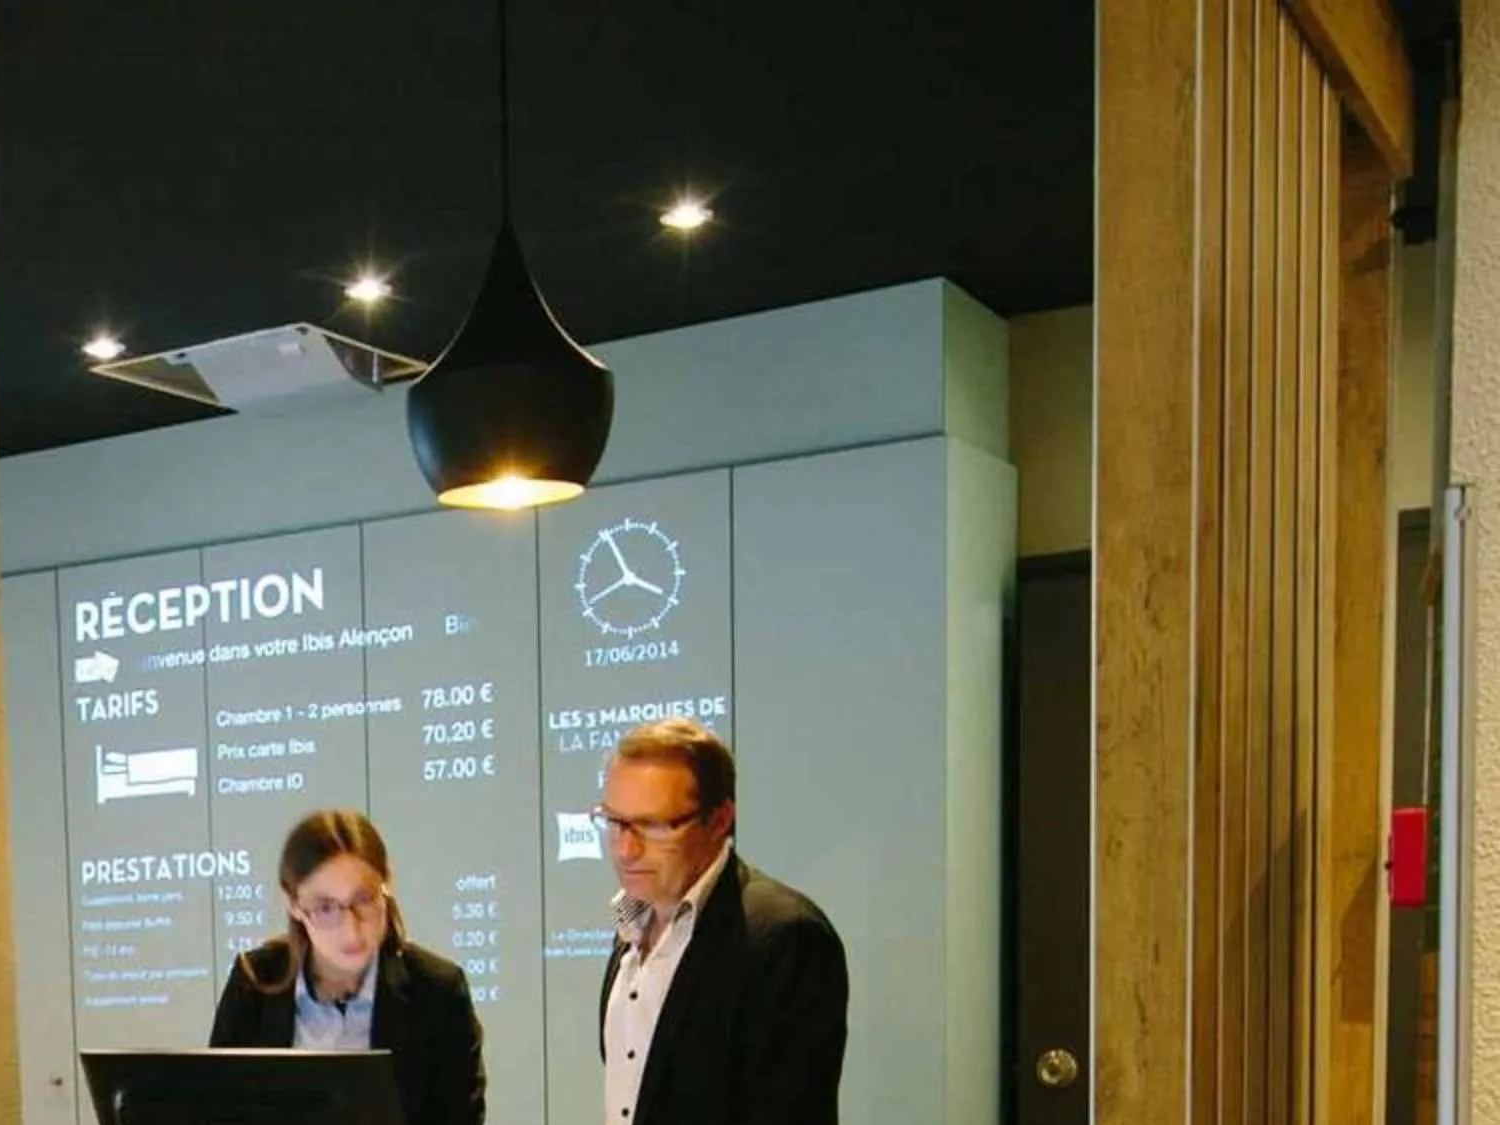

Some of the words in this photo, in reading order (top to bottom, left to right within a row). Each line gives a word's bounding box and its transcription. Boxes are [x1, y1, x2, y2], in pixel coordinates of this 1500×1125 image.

[75, 568, 324, 643] RÉCEPTION
[142, 648, 205, 671] nvenue
[209, 642, 250, 663] dans
[254, 636, 299, 658] votre
[302, 632, 335, 653] Ibis
[338, 624, 414, 649] Alençon
[584, 639, 680, 667] 17/06/2014
[75, 689, 159, 723] TARIFS
[216, 708, 282, 728] Chambre
[285, 704, 293, 721] 1
[307, 703, 318, 719] 2
[320, 697, 403, 721] personnes
[421, 685, 475, 710] 78.00
[480, 682, 494, 703] €
[549, 710, 582, 729] LES
[599, 699, 695, 725] MARQUES
[699, 696, 726, 716] DE
[216, 743, 246, 761] Prix
[248, 741, 286, 758] carte
[481, 718, 494, 739] €
[558, 732, 583, 752] LA
[217, 775, 284, 794] Chambre
[423, 756, 477, 781] 57.00
[482, 754, 495, 775] €
[563, 826, 596, 845] ibis
[81, 850, 251, 886] PRESTATIONS
